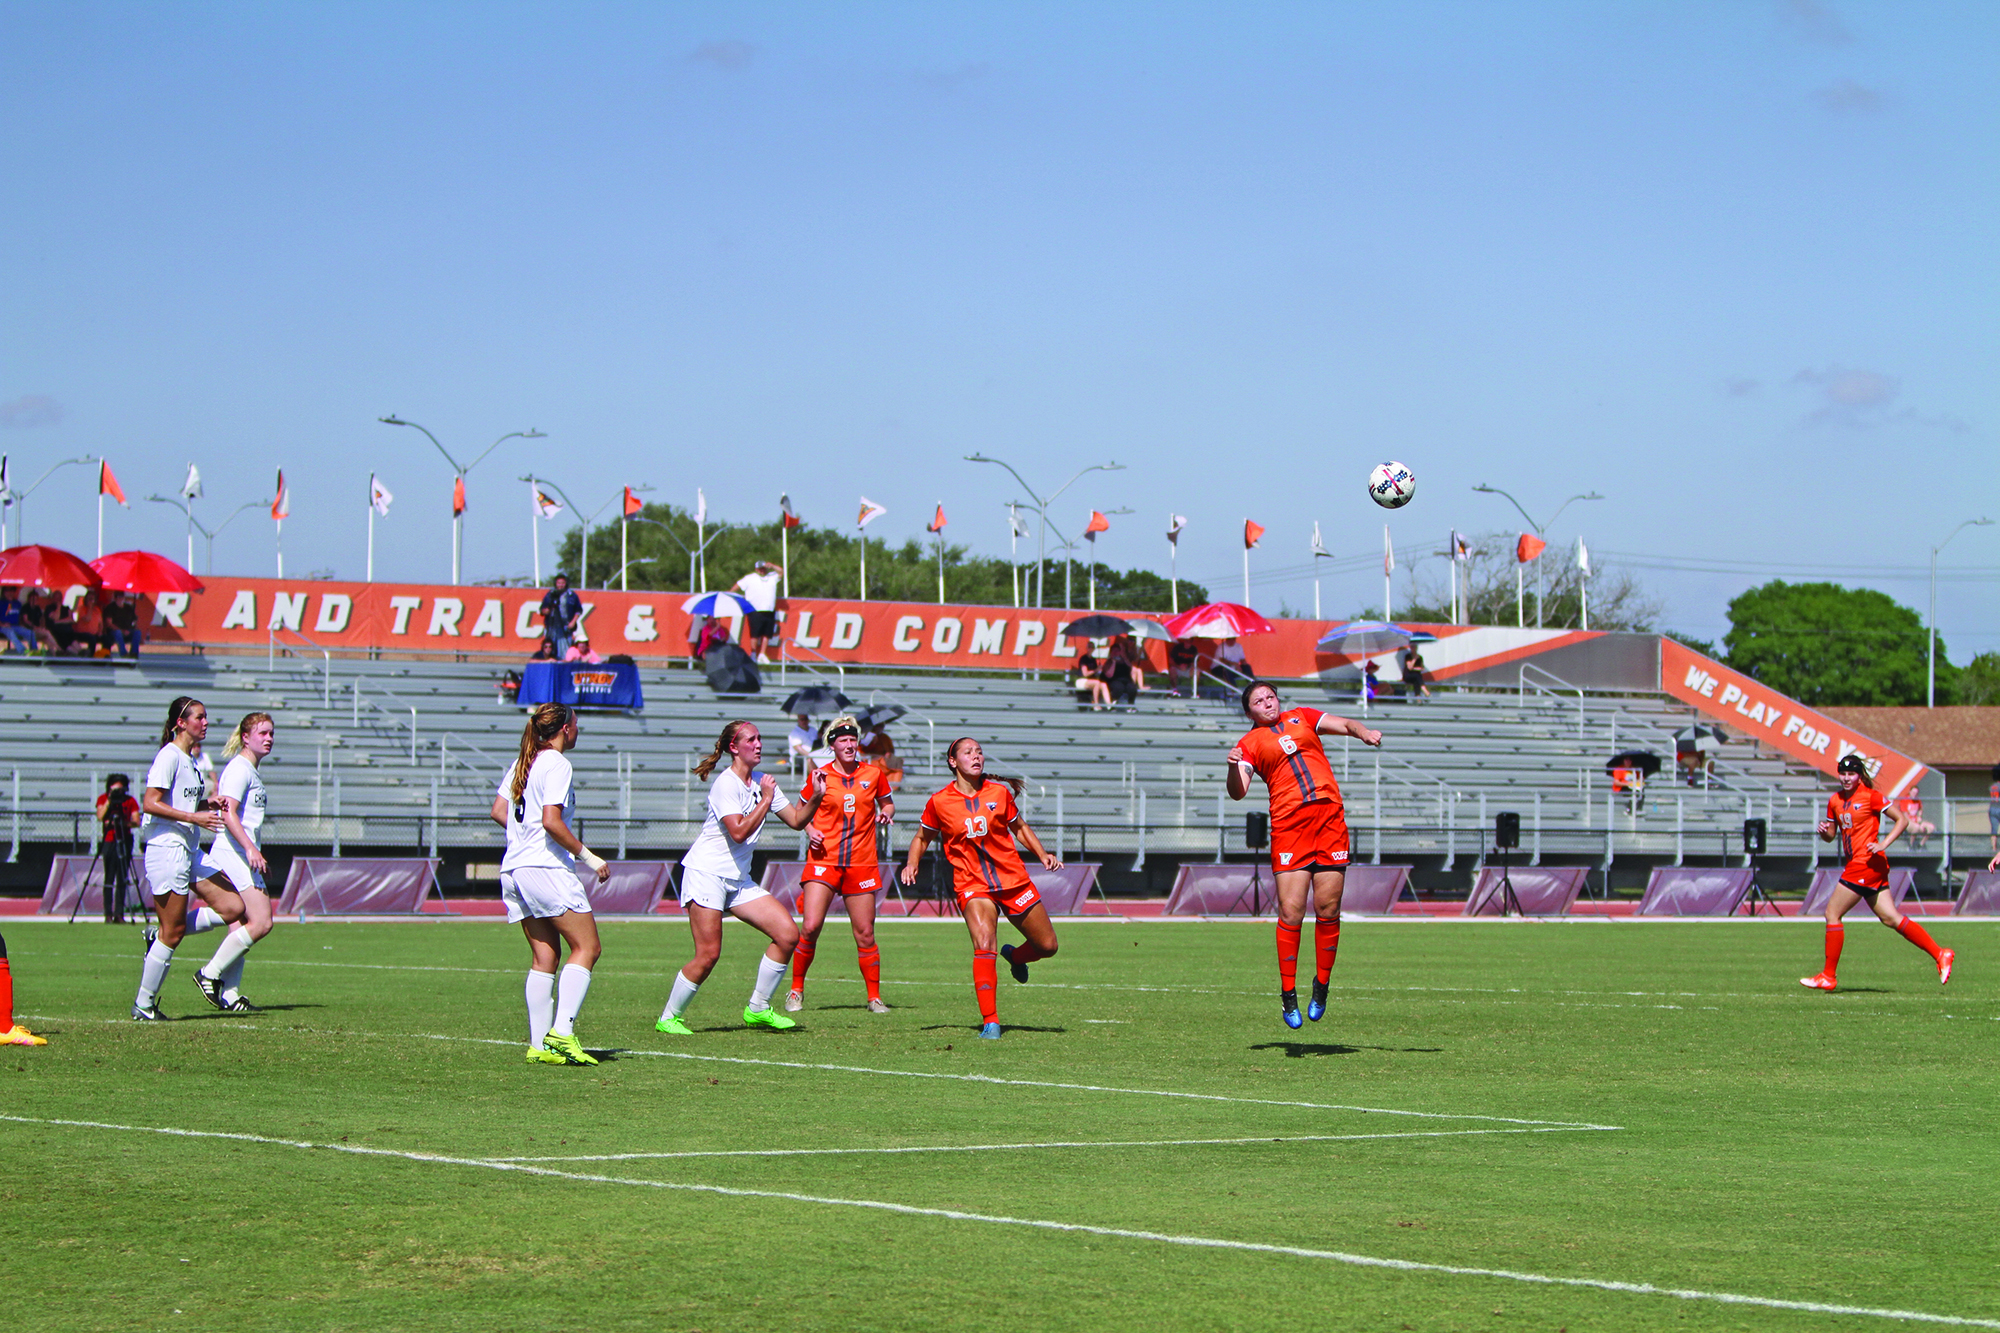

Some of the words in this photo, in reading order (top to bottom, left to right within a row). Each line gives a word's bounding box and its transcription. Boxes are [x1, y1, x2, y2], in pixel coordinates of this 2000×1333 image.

[221, 590, 356, 633] AND
[623, 604, 660, 643] &
[1684, 664, 1719, 699] WE
[1718, 683, 1782, 728] PLAY
[1782, 715, 1831, 755] FOR
[1278, 735, 1298, 755] 6
[843, 793, 856, 813] 2
[965, 816, 988, 838] 13
[1838, 812, 1853, 830] 19
